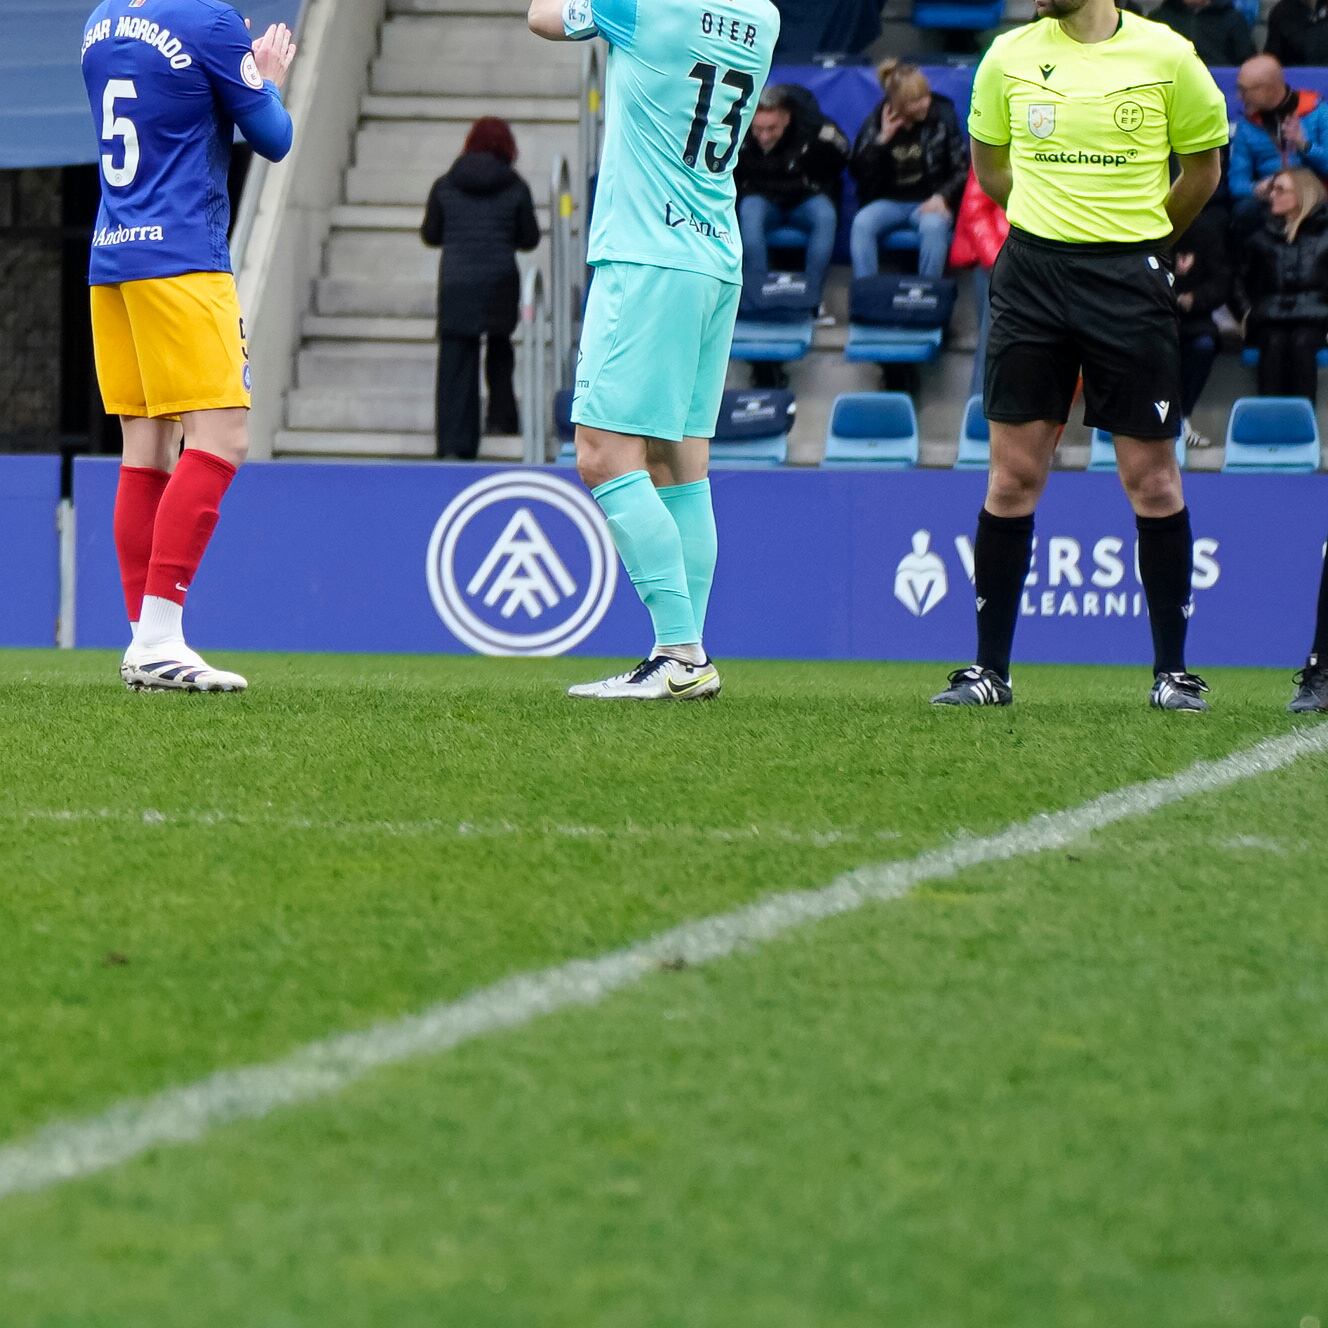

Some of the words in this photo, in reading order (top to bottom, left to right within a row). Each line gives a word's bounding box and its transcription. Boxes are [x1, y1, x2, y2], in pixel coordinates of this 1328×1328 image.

[115, 16, 193, 70] MORGADO
[701, 12, 757, 49] OIER
[101, 79, 140, 188] 5
[682, 61, 755, 173] 13
[1034, 150, 1127, 167] matchapp
[94, 224, 164, 247] Andorra
